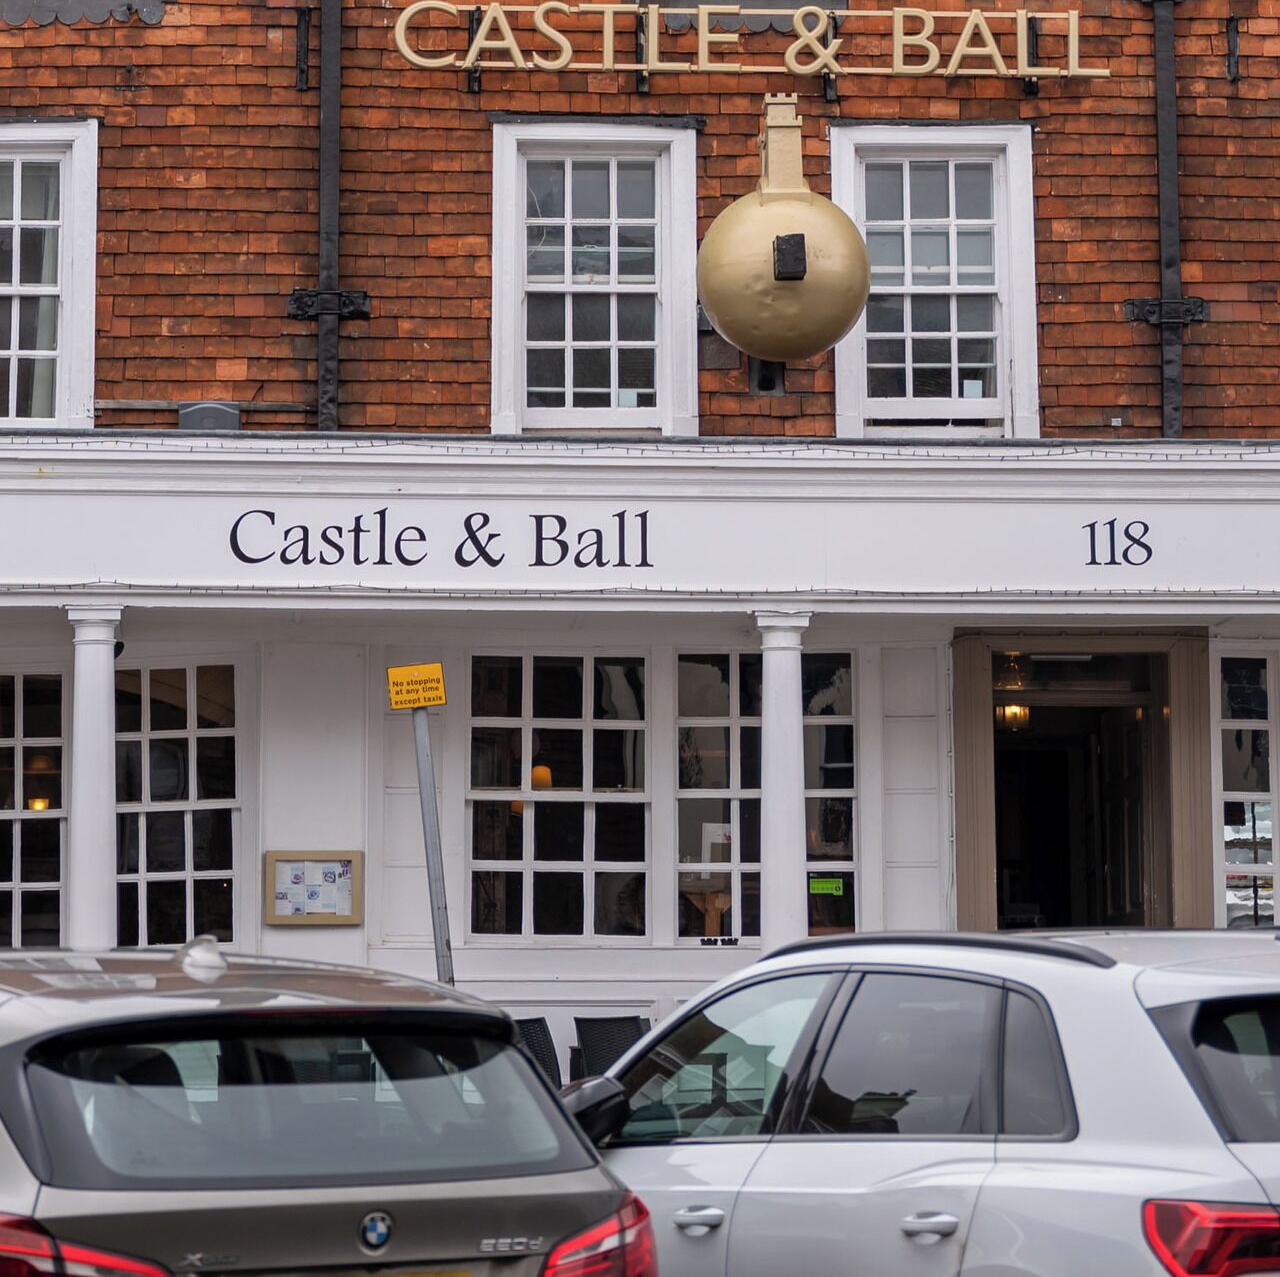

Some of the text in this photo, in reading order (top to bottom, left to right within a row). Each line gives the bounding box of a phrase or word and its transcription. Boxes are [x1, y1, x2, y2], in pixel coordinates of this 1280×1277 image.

[394, 0, 1111, 77] CASTLE & BALL
[229, 507, 655, 569] Castle & Ball
[1081, 516, 1153, 566] 118
[392, 677, 441, 688] No stopping
[394, 694, 443, 706] except taxis
